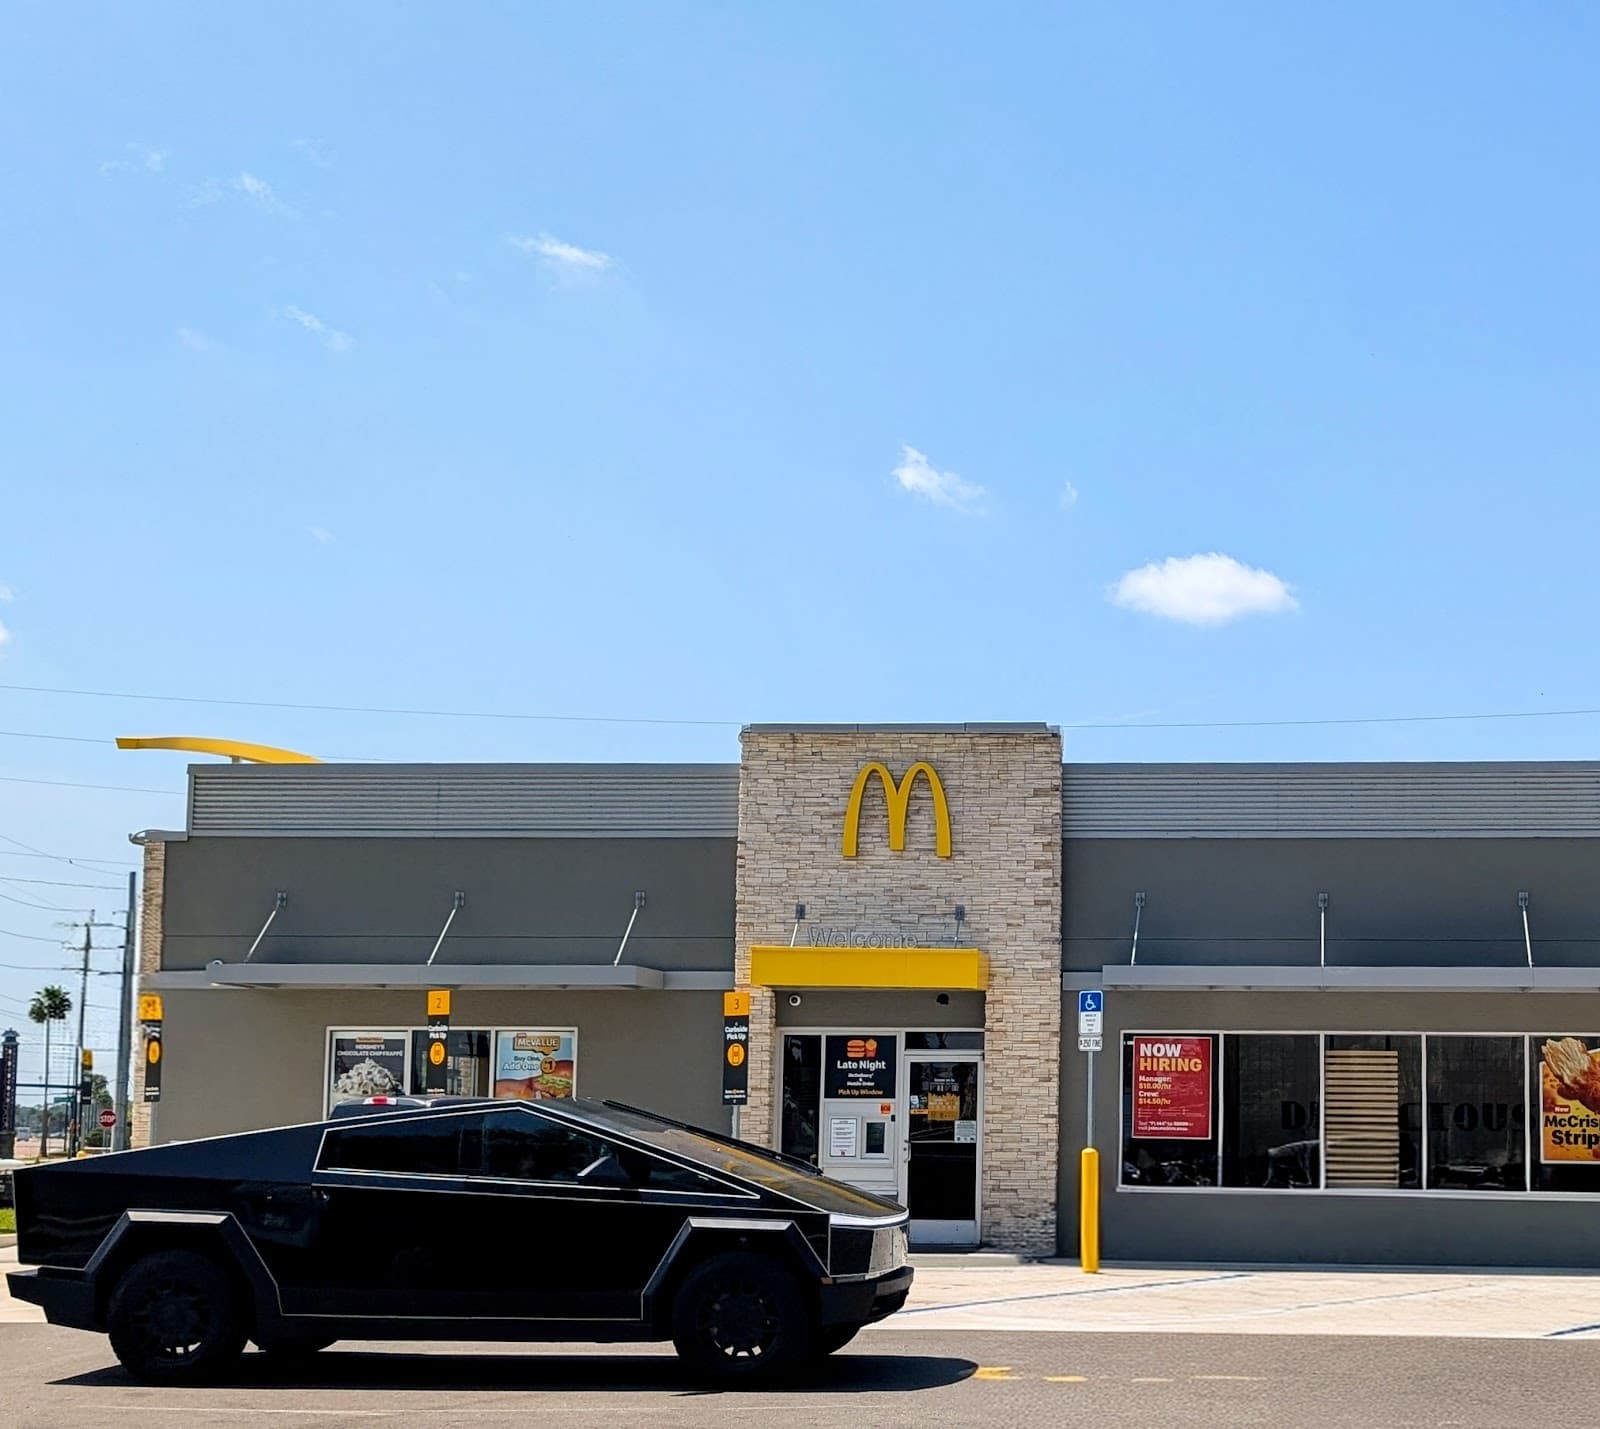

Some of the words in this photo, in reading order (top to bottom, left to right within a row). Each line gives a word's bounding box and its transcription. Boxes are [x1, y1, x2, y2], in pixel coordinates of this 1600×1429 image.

[807, 927, 918, 949] Welcome
[436, 998, 441, 1008] 2
[734, 999, 740, 1009] 3
[738, 1033, 746, 1041] Up
[1140, 1043, 1181, 1057] NOW
[503, 1062, 521, 1070] Add
[522, 1062, 539, 1070] One
[837, 1060, 858, 1069] Late
[859, 1060, 886, 1071] Night
[1140, 1058, 1202, 1072] HIRING
[1139, 1076, 1172, 1084] Manager:
[1544, 1115, 1600, 1128] McCris
[1552, 1129, 1600, 1149] Strip
